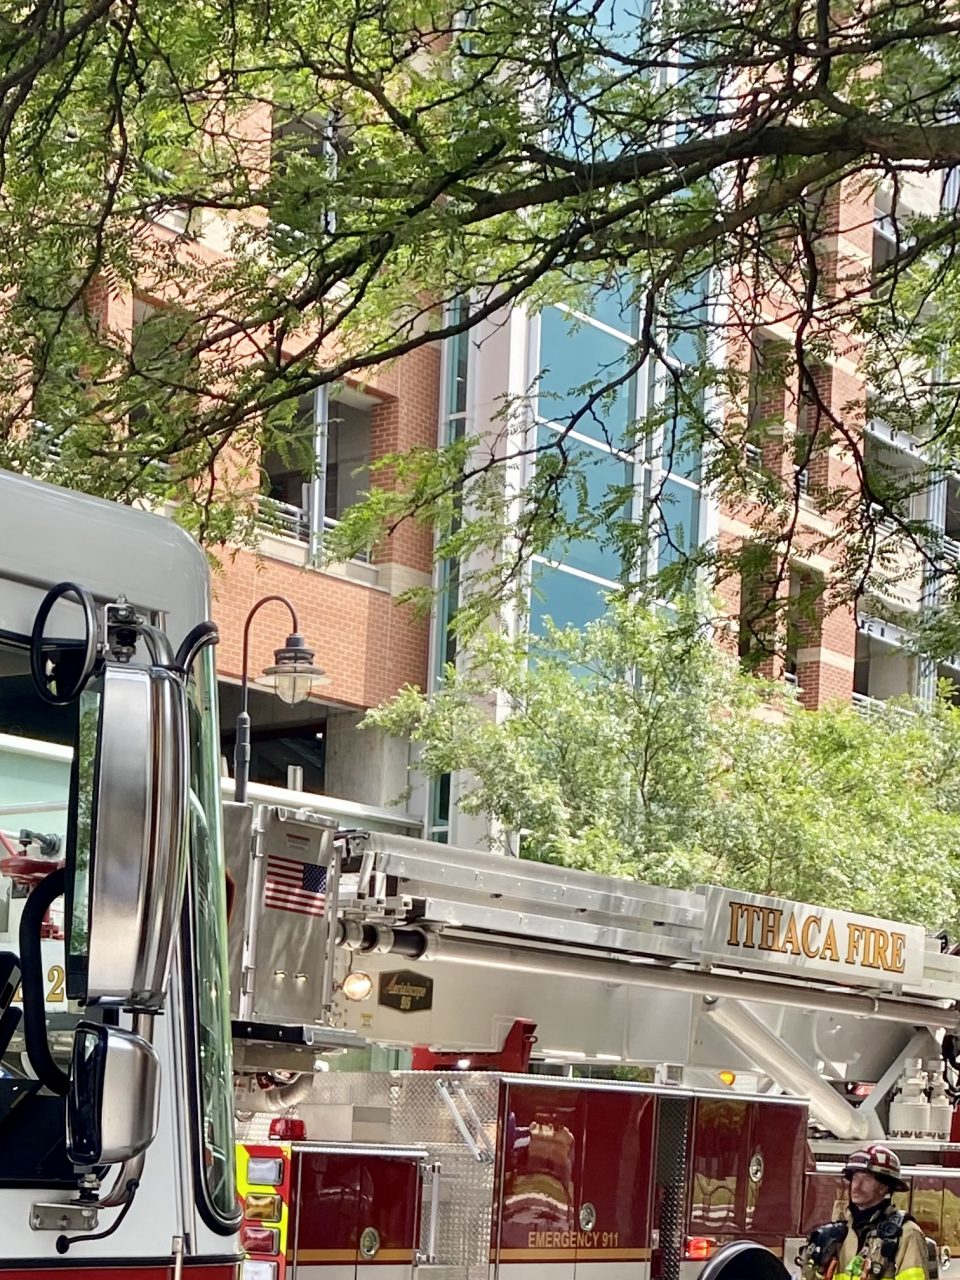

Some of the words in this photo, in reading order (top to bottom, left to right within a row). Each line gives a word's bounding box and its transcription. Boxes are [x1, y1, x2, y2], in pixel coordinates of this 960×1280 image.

[727, 901, 840, 962] ITHACA
[845, 922, 906, 974] FIRE
[46, 965, 65, 1002] 2
[528, 1231, 600, 1248] EMERGENCY
[602, 1232, 619, 1248] 911
